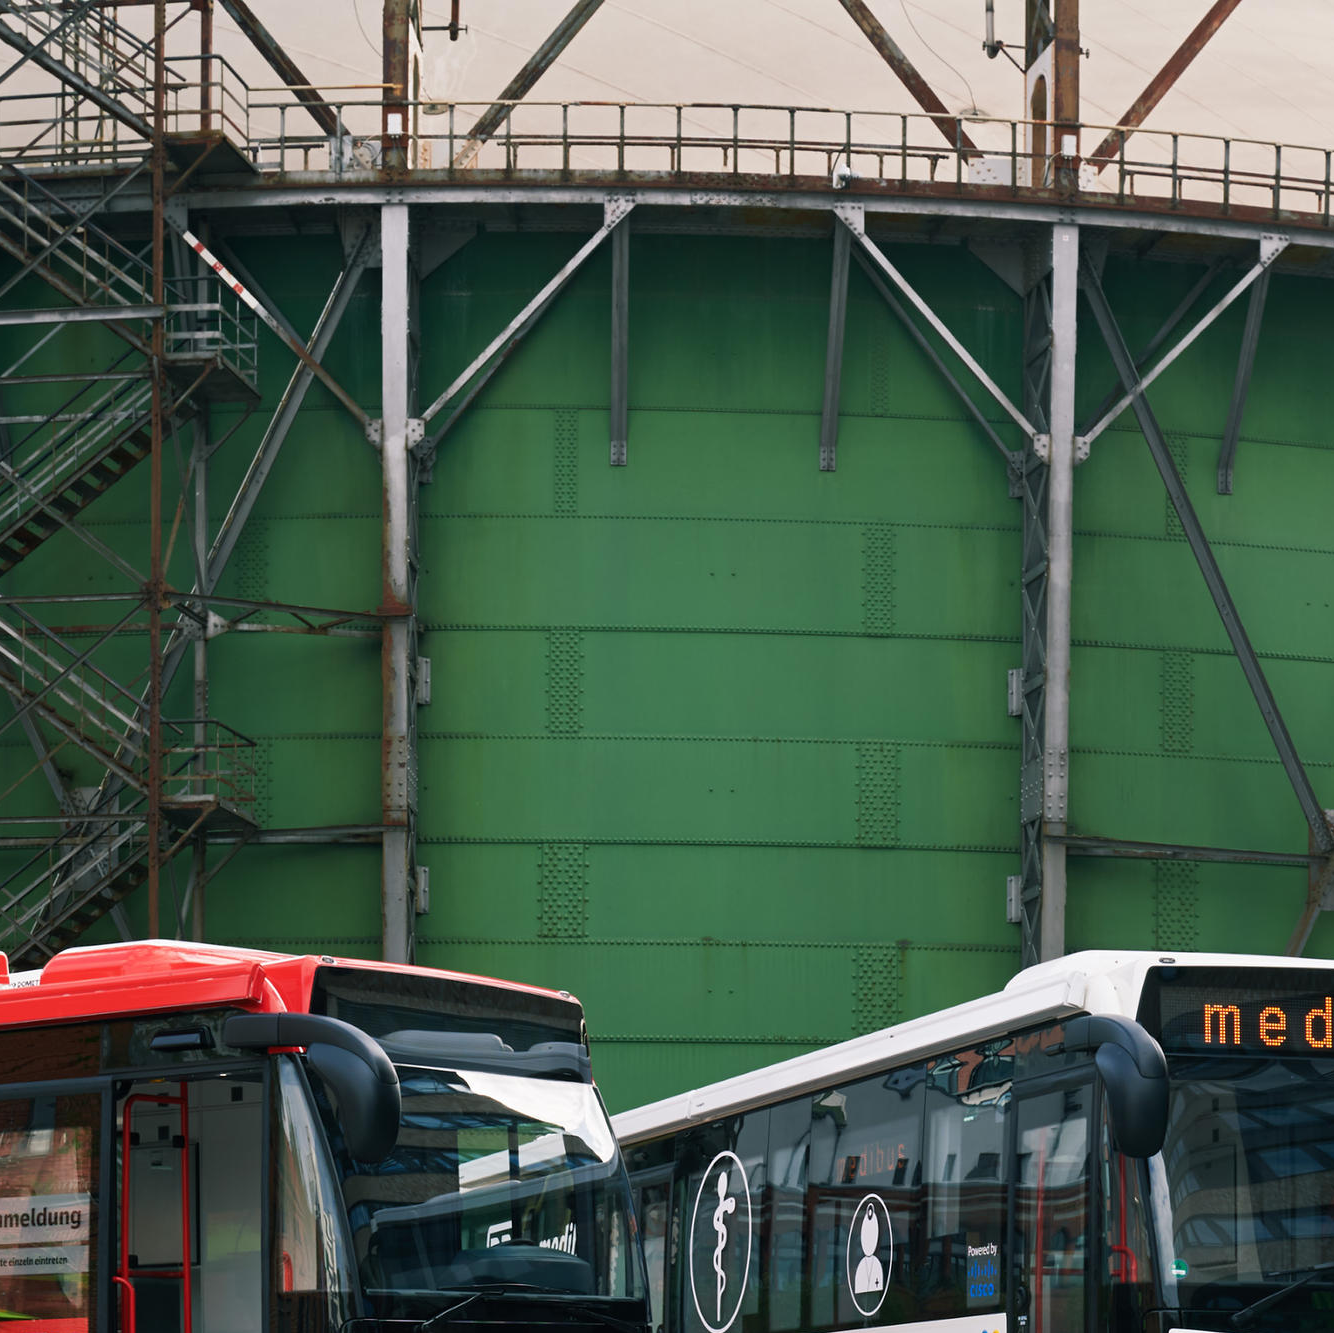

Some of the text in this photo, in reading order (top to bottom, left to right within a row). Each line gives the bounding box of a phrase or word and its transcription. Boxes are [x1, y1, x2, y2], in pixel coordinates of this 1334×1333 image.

[967, 1242, 998, 1257] Powered by
[9, 1256, 33, 1266] einzeln
[970, 1282, 995, 1298] CISCO
